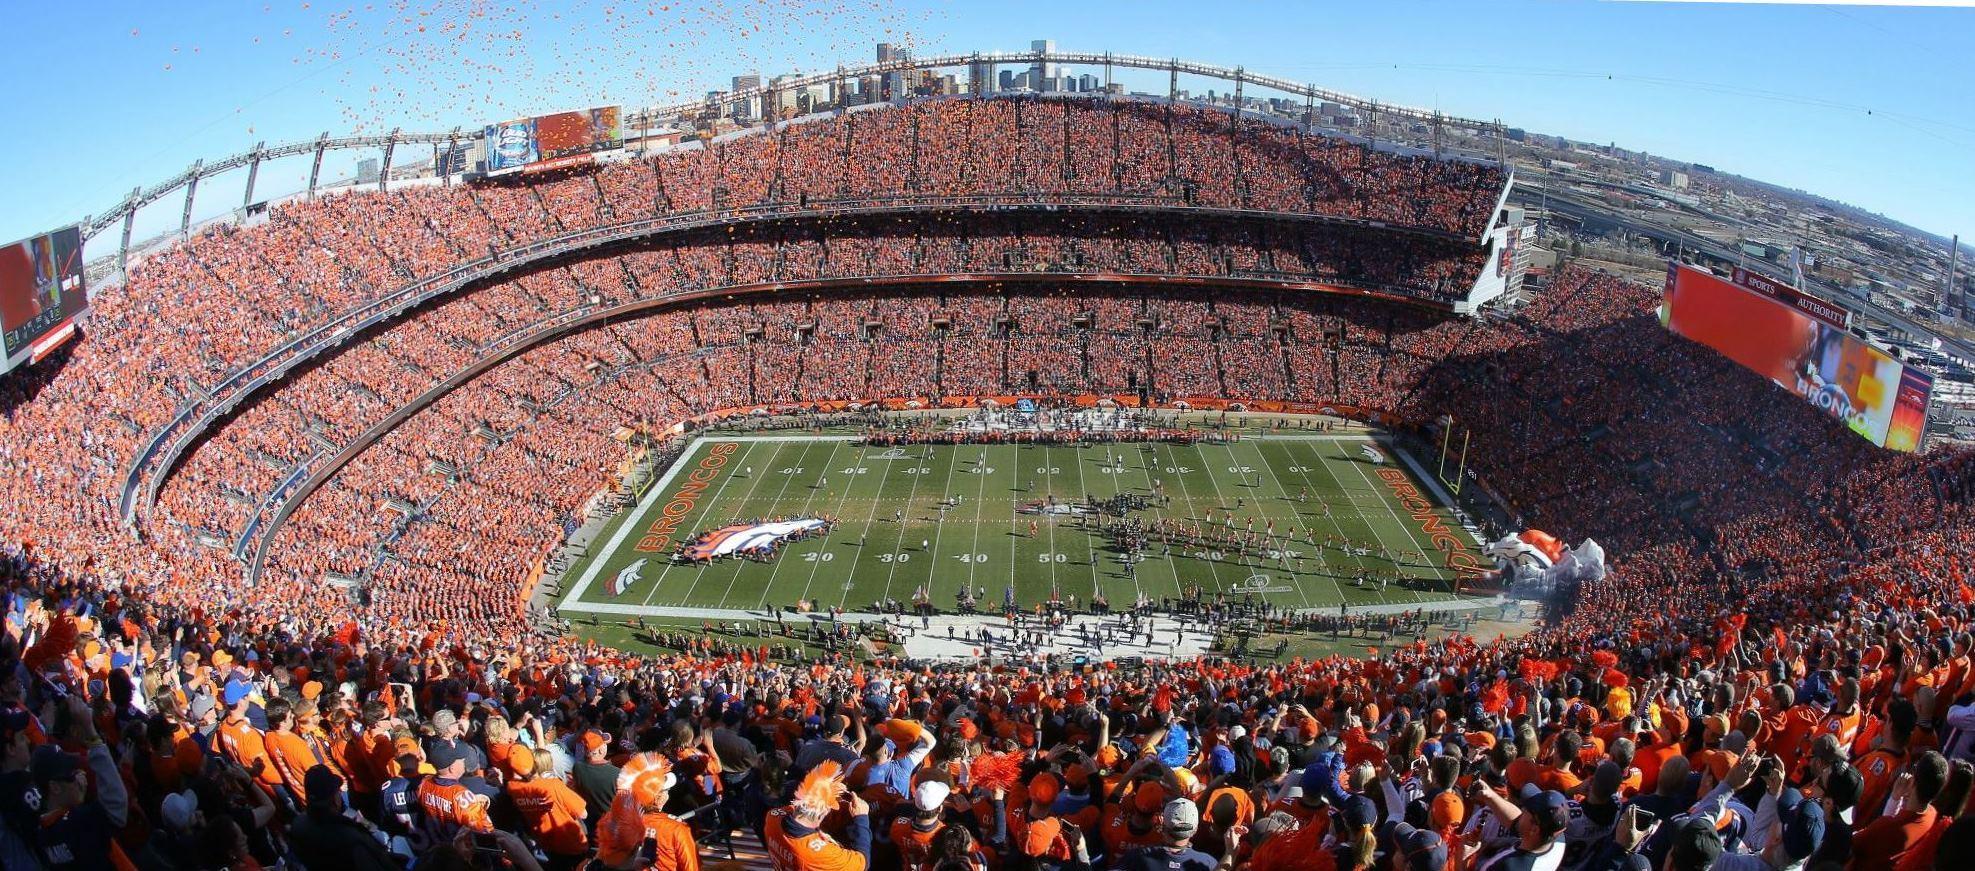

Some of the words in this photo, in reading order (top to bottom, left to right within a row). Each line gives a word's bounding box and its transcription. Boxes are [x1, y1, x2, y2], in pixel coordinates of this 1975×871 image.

[1748, 277, 1775, 295] SPORTS
[1797, 297, 1845, 325] AUTHORITY
[1037, 467, 1060, 475] 50
[634, 442, 739, 552] BRONCOS
[1375, 468, 1480, 573] BRONCO
[805, 552, 834, 562] 20
[881, 553, 909, 562] 30
[960, 553, 988, 562] 40
[1038, 553, 1067, 563] 50
